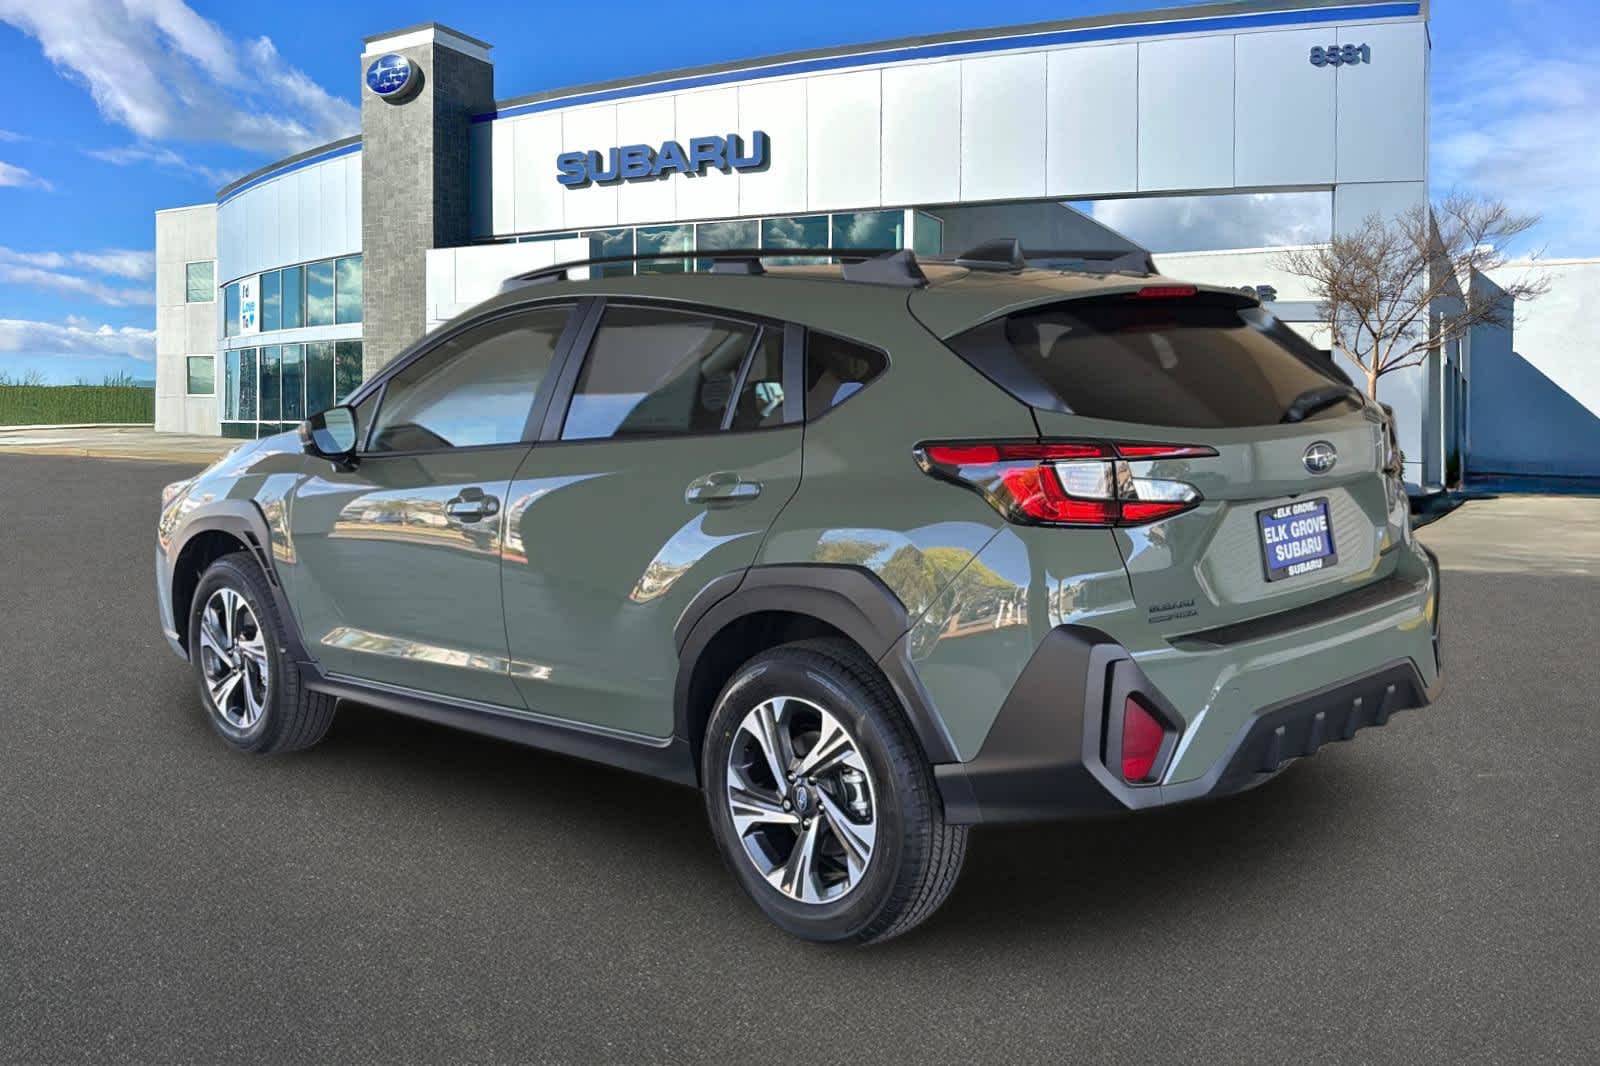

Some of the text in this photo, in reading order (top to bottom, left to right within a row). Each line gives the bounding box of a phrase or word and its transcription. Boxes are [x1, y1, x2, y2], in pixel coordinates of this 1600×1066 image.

[556, 130, 771, 190] SUBARU
[1277, 501, 1315, 518] ELK GROVE
[1263, 515, 1328, 544] ELK GROVE
[1275, 535, 1322, 561] SUBARU
[1288, 558, 1323, 576] SUBARU
